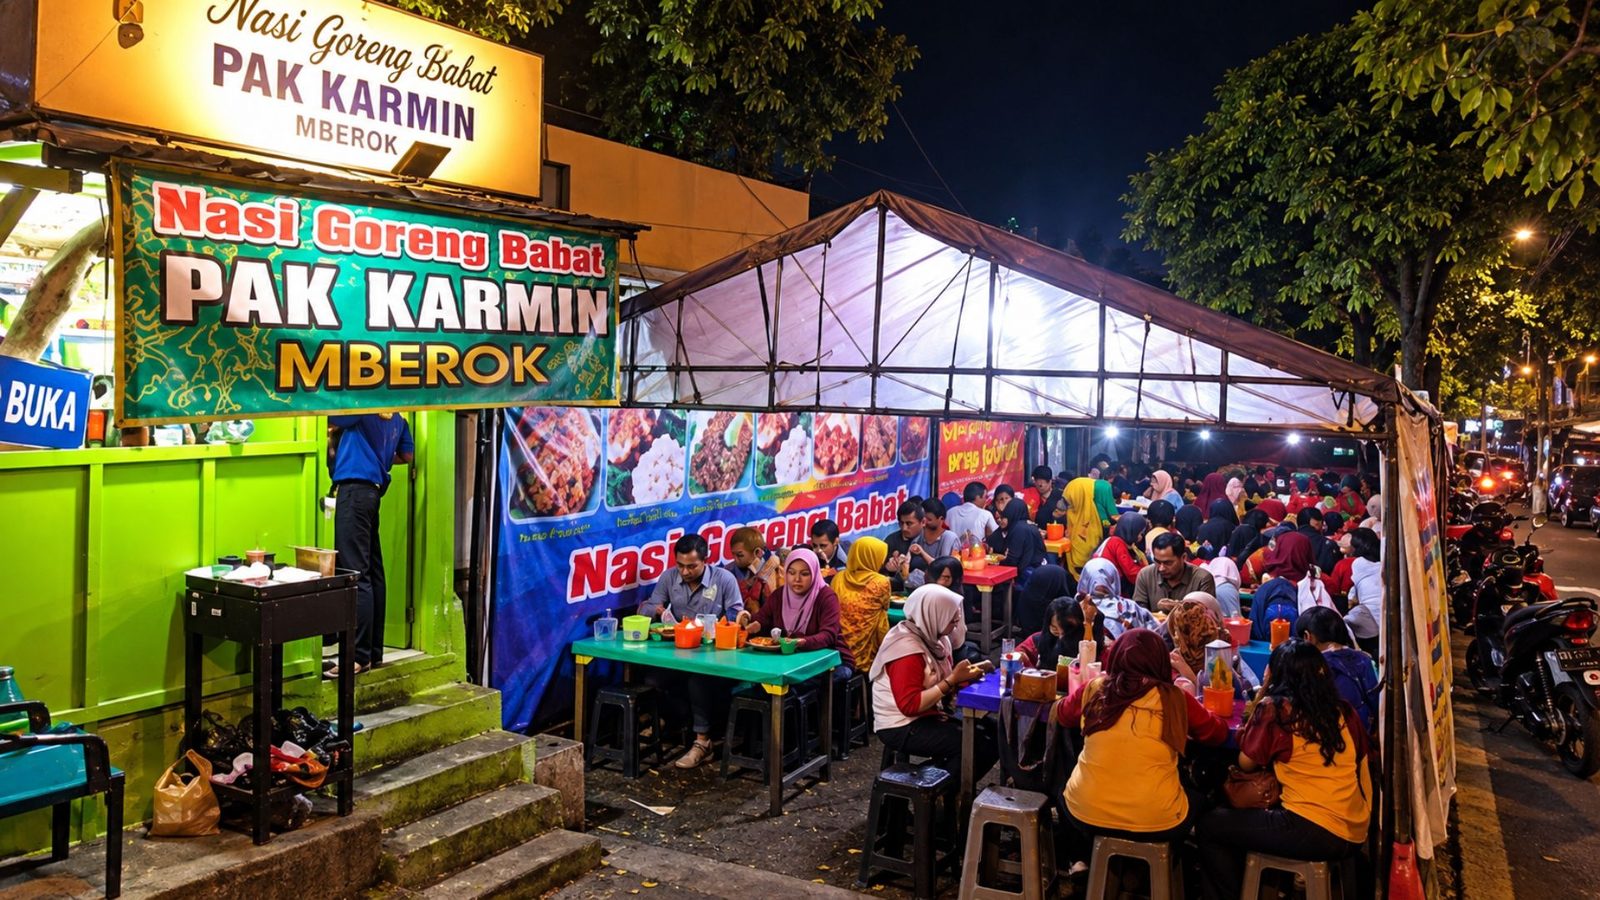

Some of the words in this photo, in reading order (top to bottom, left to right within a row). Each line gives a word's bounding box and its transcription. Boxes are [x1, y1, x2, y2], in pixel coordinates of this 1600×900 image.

[207, 0, 307, 43] Nasi
[309, 14, 413, 84] Goreng
[416, 44, 498, 95] Babat
[212, 42, 304, 105] PAK
[321, 69, 475, 142] KARMIN
[296, 114, 398, 156] MBEROK
[153, 182, 301, 248] Nasi
[313, 204, 489, 271] Goreng
[499, 230, 606, 277] Babat
[163, 252, 342, 328] PAK
[366, 270, 609, 337] KARMIN
[4, 379, 77, 432] BUKA
[276, 341, 550, 391] MBEROK
[567, 527, 684, 604] Nasi
[697, 507, 829, 566] Gen
